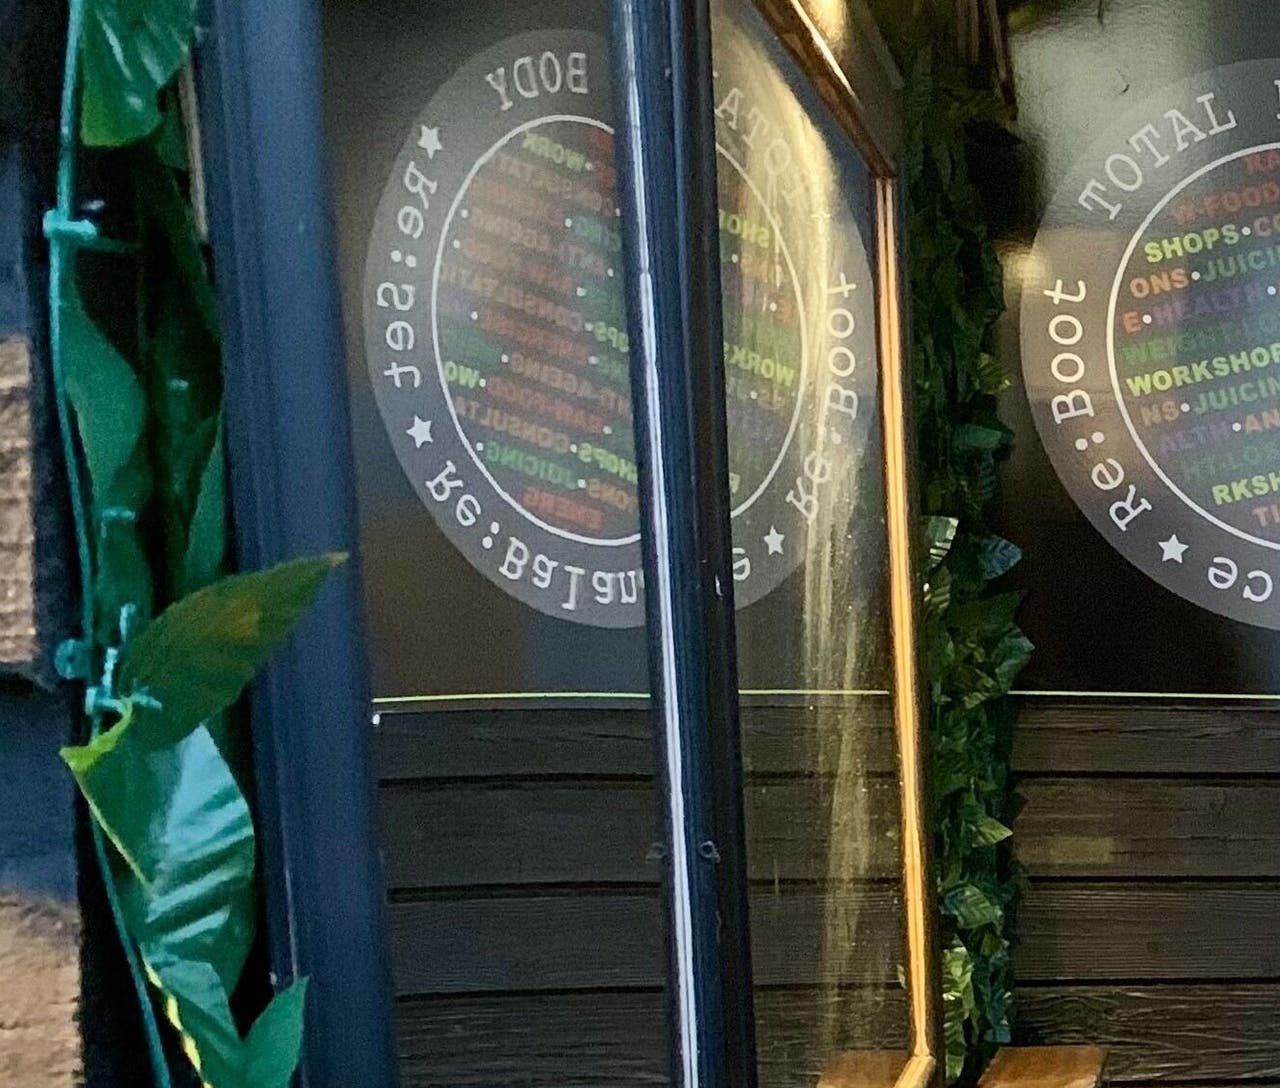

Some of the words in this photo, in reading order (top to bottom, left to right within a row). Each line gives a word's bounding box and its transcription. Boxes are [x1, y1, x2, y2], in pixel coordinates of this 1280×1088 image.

[1078, 91, 1237, 221] TOTAL
[1144, 224, 1240, 263] SHOPS
[1129, 267, 1191, 298] ONS
[1122, 311, 1142, 334] E
[1043, 278, 1153, 533] Re:Boot
